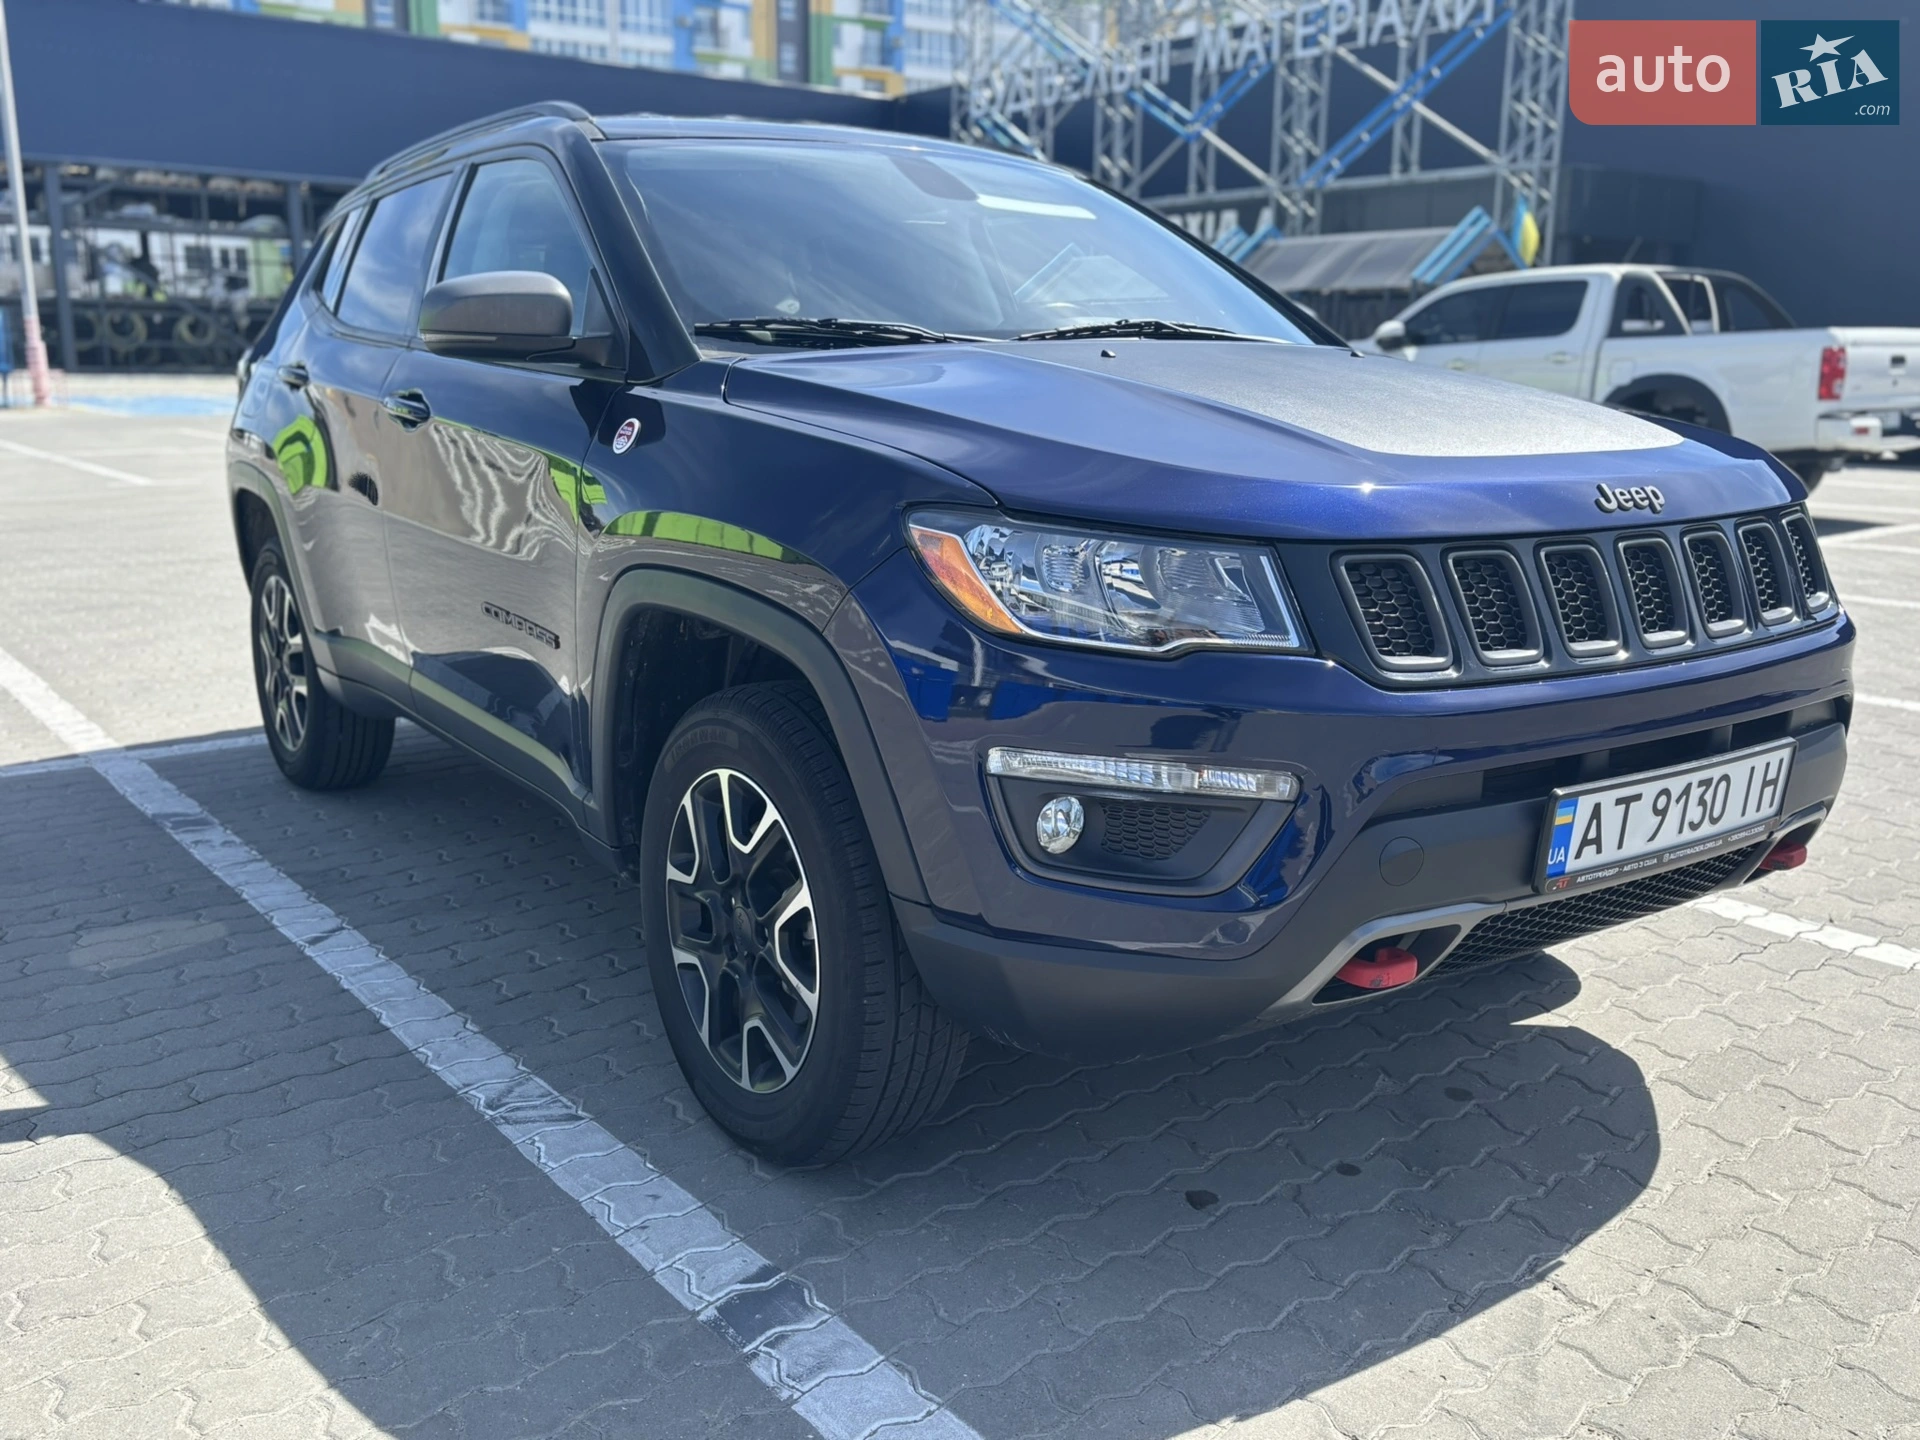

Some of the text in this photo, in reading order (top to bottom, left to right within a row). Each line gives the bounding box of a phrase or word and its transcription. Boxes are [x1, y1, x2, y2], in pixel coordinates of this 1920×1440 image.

[1595, 483, 1665, 514] Jeep
[481, 601, 560, 649] COMPASS
[1574, 757, 1784, 860] AT 9130 IH
[1548, 846, 1565, 865] UA
